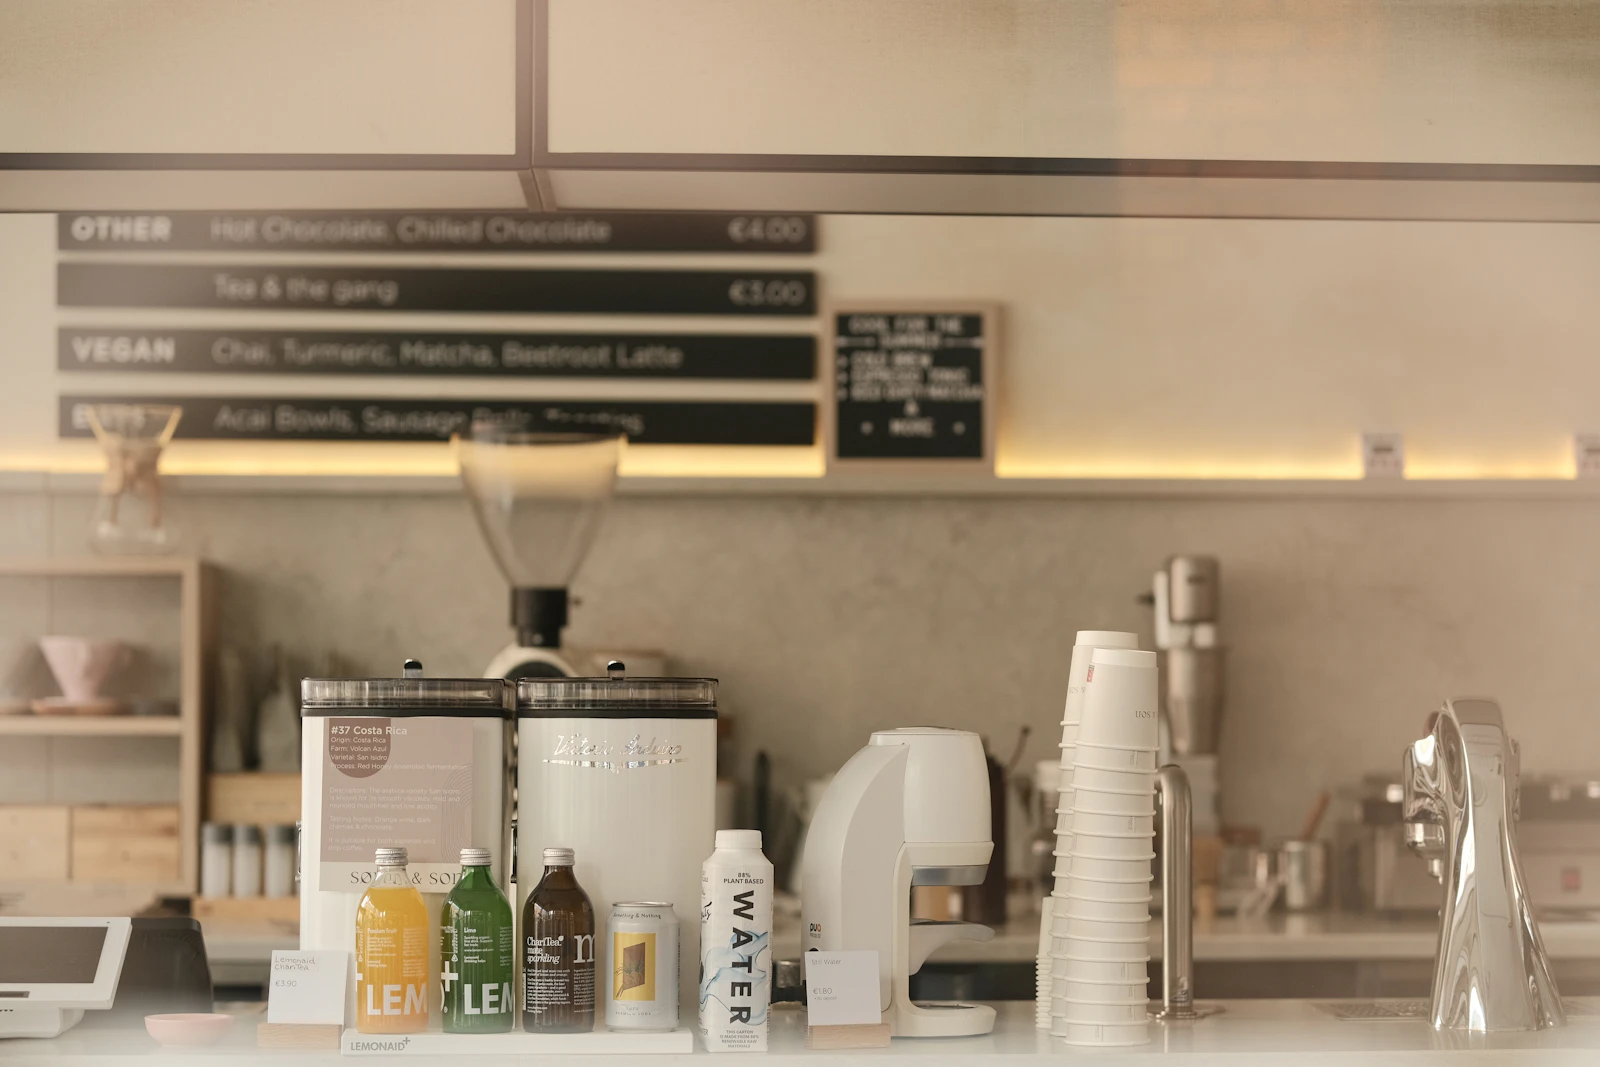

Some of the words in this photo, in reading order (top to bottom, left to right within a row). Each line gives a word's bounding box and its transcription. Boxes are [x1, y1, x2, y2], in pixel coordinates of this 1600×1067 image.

[72, 217, 170, 240] OTHER
[211, 217, 256, 241] Hot
[397, 216, 483, 242] Chilled
[486, 217, 611, 243] Chocolate
[728, 218, 805, 242] €4.00
[215, 275, 256, 300] Tea
[261, 275, 281, 299] &
[287, 276, 328, 300] the
[333, 279, 397, 304] gang
[729, 281, 805, 305] €3.00
[72, 338, 174, 362] VEGAN
[503, 342, 610, 368] Beetroot
[617, 343, 682, 368] Latte
[331, 726, 350, 735] #37
[353, 726, 382, 735] Costa
[385, 726, 407, 735] Rica
[372, 763, 391, 771] Honey
[427, 763, 467, 771] fermentation
[429, 788, 441, 796] San
[411, 871, 422, 885] &
[809, 923, 821, 932] DUO
[275, 956, 316, 965] Lemonaid
[527, 953, 560, 965] sparkling
[730, 890, 754, 1024] WATER
[811, 958, 822, 966] Still
[274, 963, 310, 971] ChariTea
[275, 979, 298, 988] €3.90
[812, 987, 833, 995] €1.80
